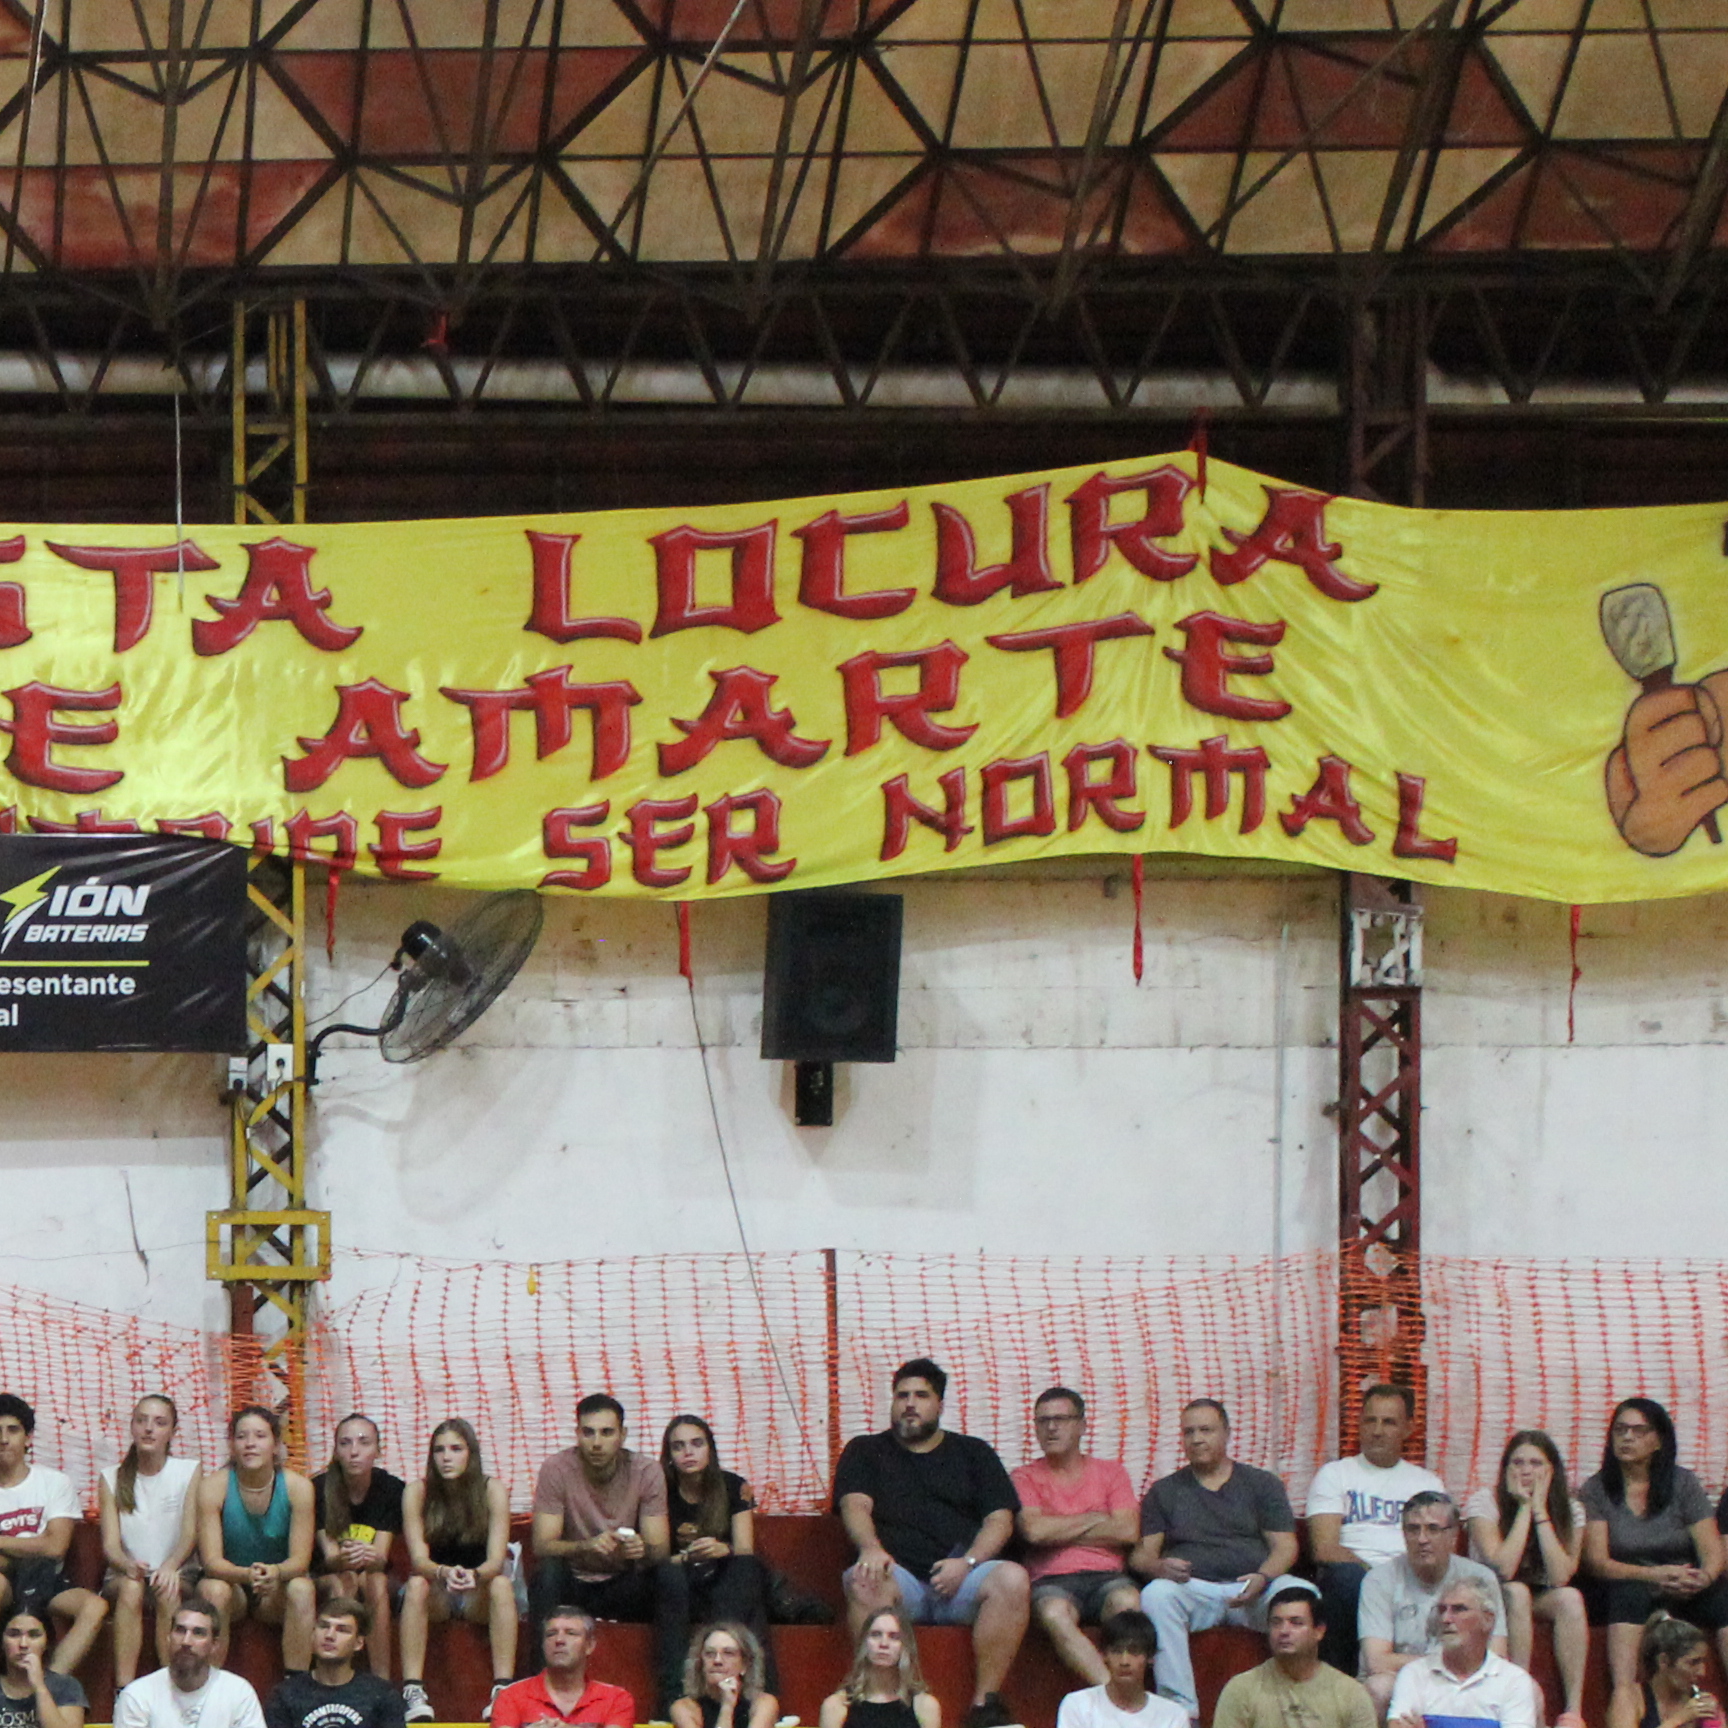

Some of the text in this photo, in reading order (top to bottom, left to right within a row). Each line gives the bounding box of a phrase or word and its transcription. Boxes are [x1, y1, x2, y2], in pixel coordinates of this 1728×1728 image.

[523, 463, 1379, 646] LOCURA
[280, 609, 1293, 793] AMARTE
[538, 787, 798, 891] SER
[880, 734, 1459, 863] NORMAL
[23, 923, 149, 944] BATERIAS
